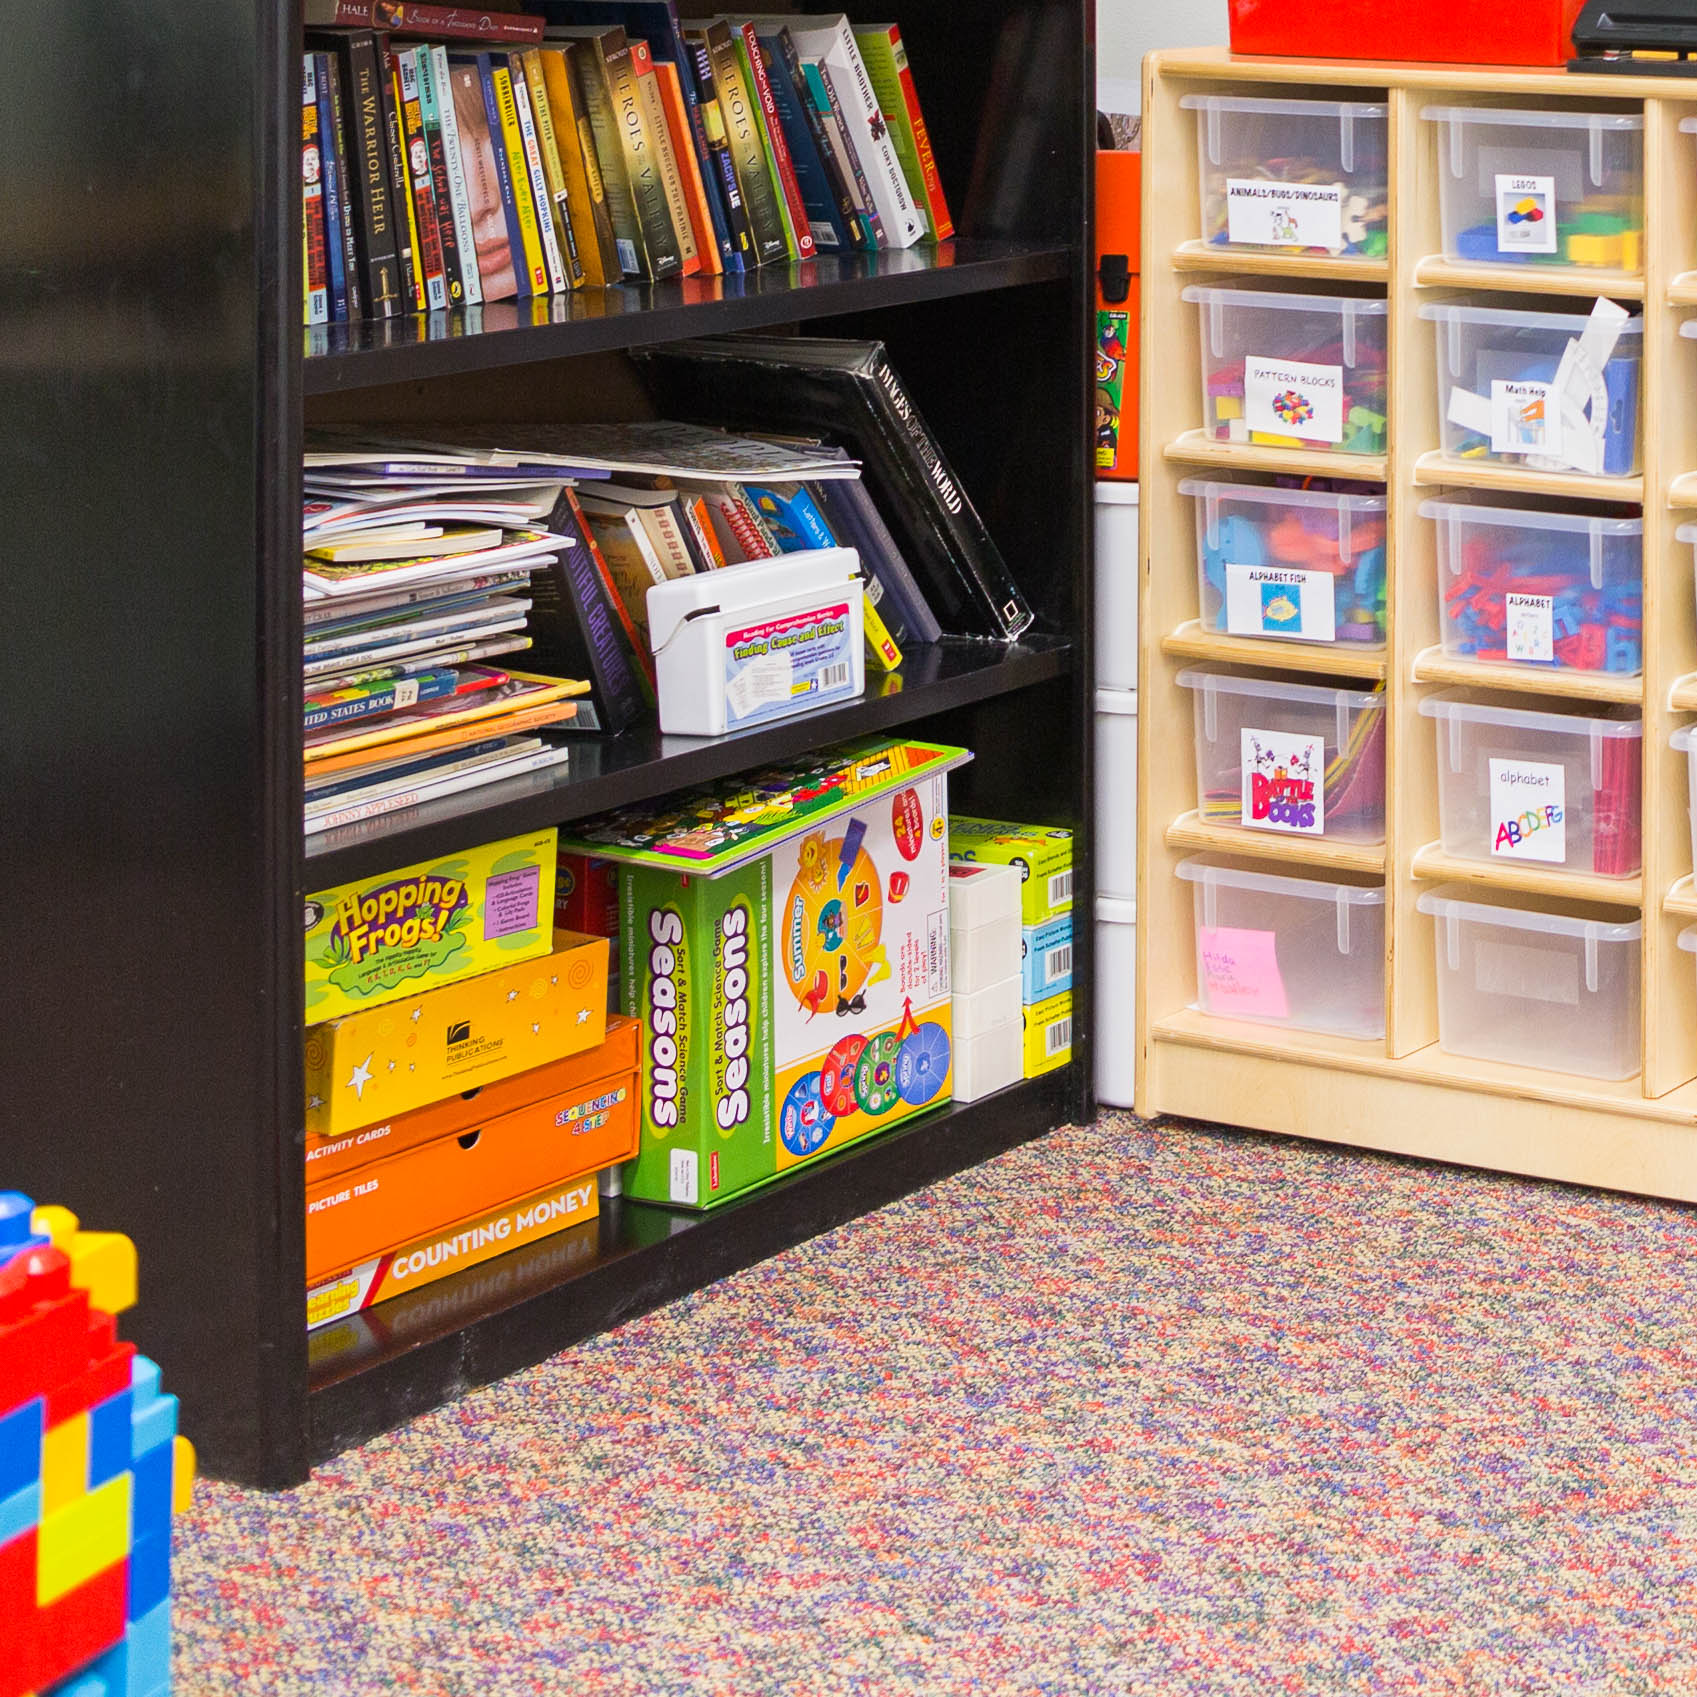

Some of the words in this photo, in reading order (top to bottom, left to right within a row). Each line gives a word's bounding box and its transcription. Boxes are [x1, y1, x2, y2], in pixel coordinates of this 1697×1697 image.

[342, 3, 368, 16] HALE
[748, 31, 767, 82] TOUCHING
[762, 89, 775, 113] VOID
[843, 28, 857, 64] LITTLE
[853, 63, 874, 112] BROTHER
[363, 96, 380, 184] WARRIOR
[615, 64, 646, 152] HEROES
[639, 168, 669, 250] VALLEY
[720, 55, 750, 141] HEROES
[746, 155, 773, 233] VALLEY
[914, 119, 934, 172] FEVER
[528, 138, 539, 166] GREAT
[536, 188, 552, 234] HOPKINS
[729, 191, 741, 210] LIE
[370, 186, 386, 234] HEIR
[1253, 369, 1297, 384] PATTERN
[1300, 375, 1336, 388] BLOCKS
[1504, 384, 1526, 397] Math
[878, 363, 911, 420] IMAGES
[930, 460, 963, 515] WORLD
[1249, 572, 1289, 582] ALPHABET
[1289, 573, 1307, 584] FISH
[1509, 595, 1551, 609] ALPHABET
[733, 642, 769, 661] Finding
[771, 637, 797, 651] Cause
[799, 630, 816, 643] and
[817, 621, 845, 638] Effect
[330, 702, 366, 721] STATES
[368, 696, 394, 711] BOOK
[1252, 773, 1315, 802] BATTLE
[1500, 770, 1550, 787] alphabet
[323, 807, 363, 828] JOHNNY
[364, 794, 419, 816] APPLESEED
[1495, 804, 1564, 852] ABCDEFG
[335, 874, 465, 936] Hopping
[348, 909, 450, 964] Frogs!
[712, 919, 722, 957] Game
[791, 895, 805, 982] Summer
[677, 949, 686, 974] Sort
[713, 961, 723, 1009] Science
[650, 908, 683, 1129] Seasons
[678, 992, 688, 1031] Match
[717, 906, 750, 1129] Seasons
[446, 1035, 486, 1054] THINKING
[446, 1038, 504, 1063] PUBLICATIONS
[713, 1012, 723, 1051] Match
[678, 1034, 688, 1082] Science
[714, 1069, 723, 1096] Sort
[858, 1064, 870, 1098] Spring
[555, 1088, 626, 1128] SEQUENCING
[572, 1120, 583, 1136] 4
[583, 1112, 609, 1133] STEP
[678, 1086, 688, 1124] Game
[306, 1138, 354, 1162] ACTIVITY
[356, 1125, 391, 1145] CARDS
[308, 1190, 351, 1214] PICTURE
[354, 1179, 379, 1196] TILES
[392, 1217, 512, 1280] COUNTING
[516, 1184, 592, 1233] MONEY
